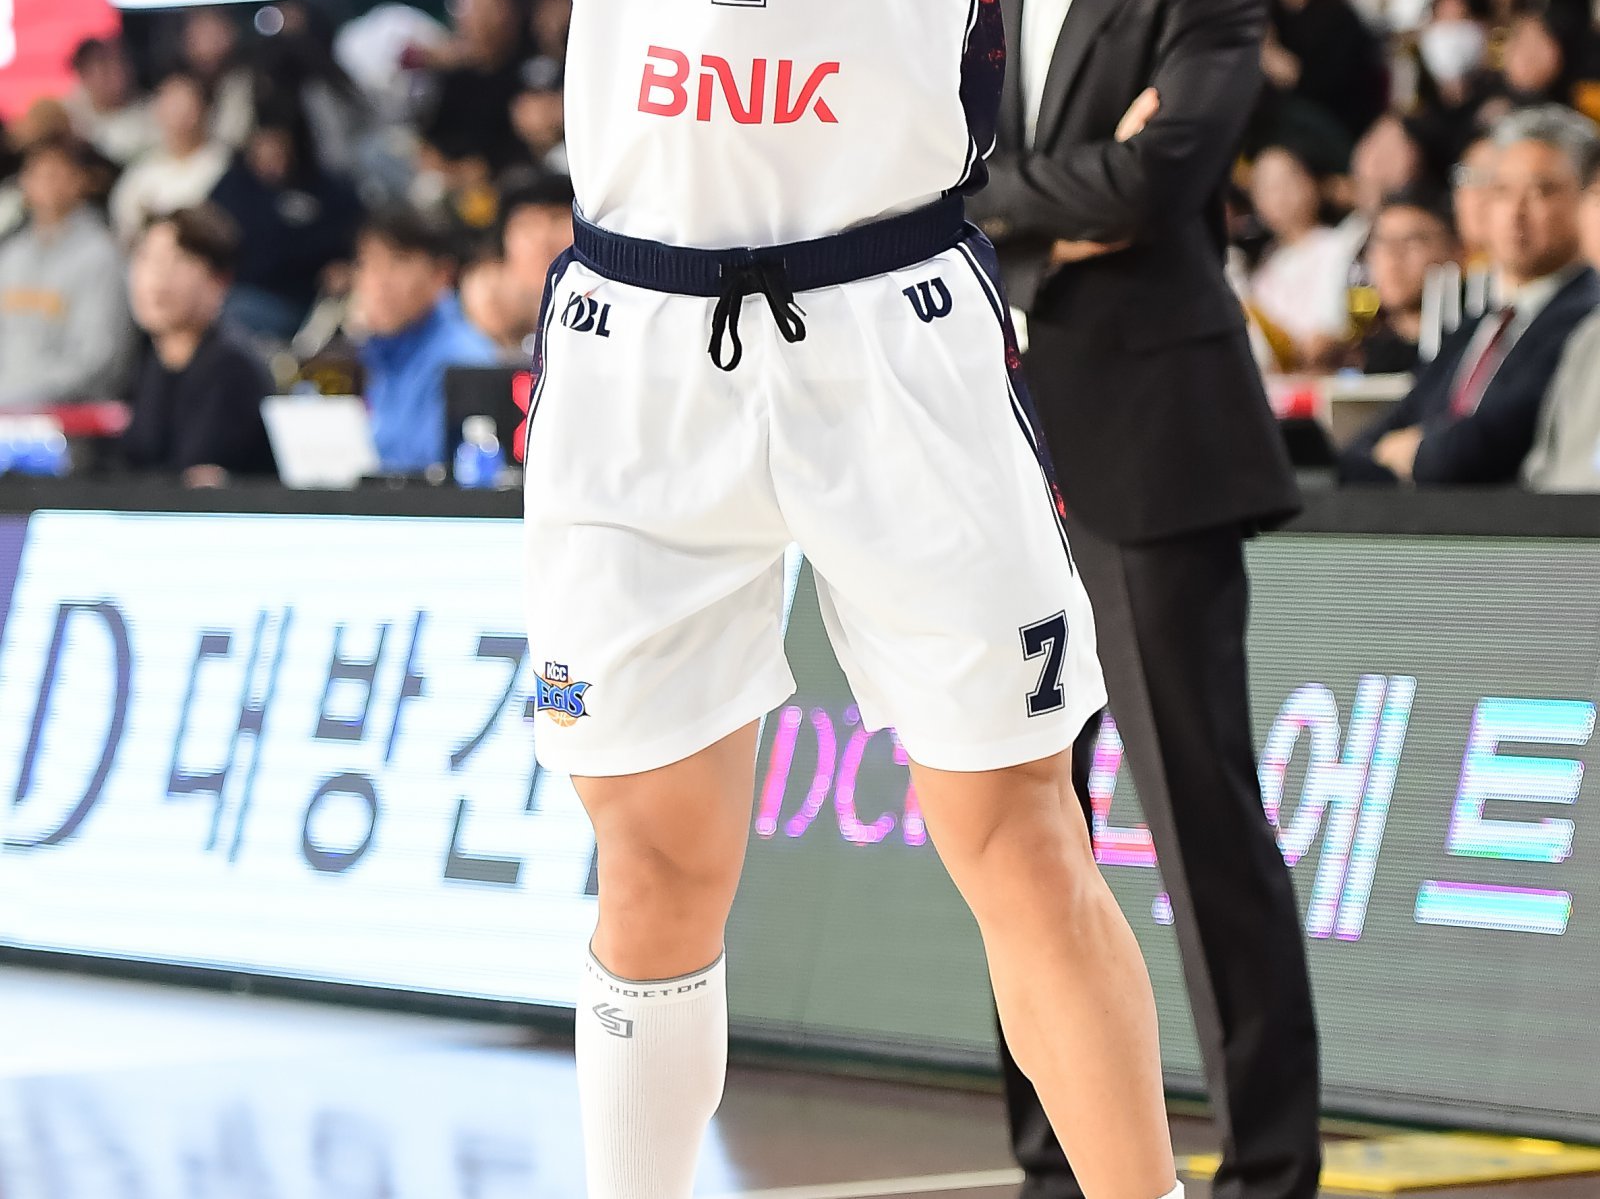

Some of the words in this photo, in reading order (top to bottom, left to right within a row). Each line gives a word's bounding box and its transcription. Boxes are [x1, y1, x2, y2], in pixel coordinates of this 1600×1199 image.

[637, 45, 841, 125] BNK
[561, 291, 611, 338] KBL
[534, 672, 592, 718] EGIS
[546, 661, 569, 682] KCC
[1019, 610, 1069, 718] 7
[165, 608, 598, 896] 대방건
